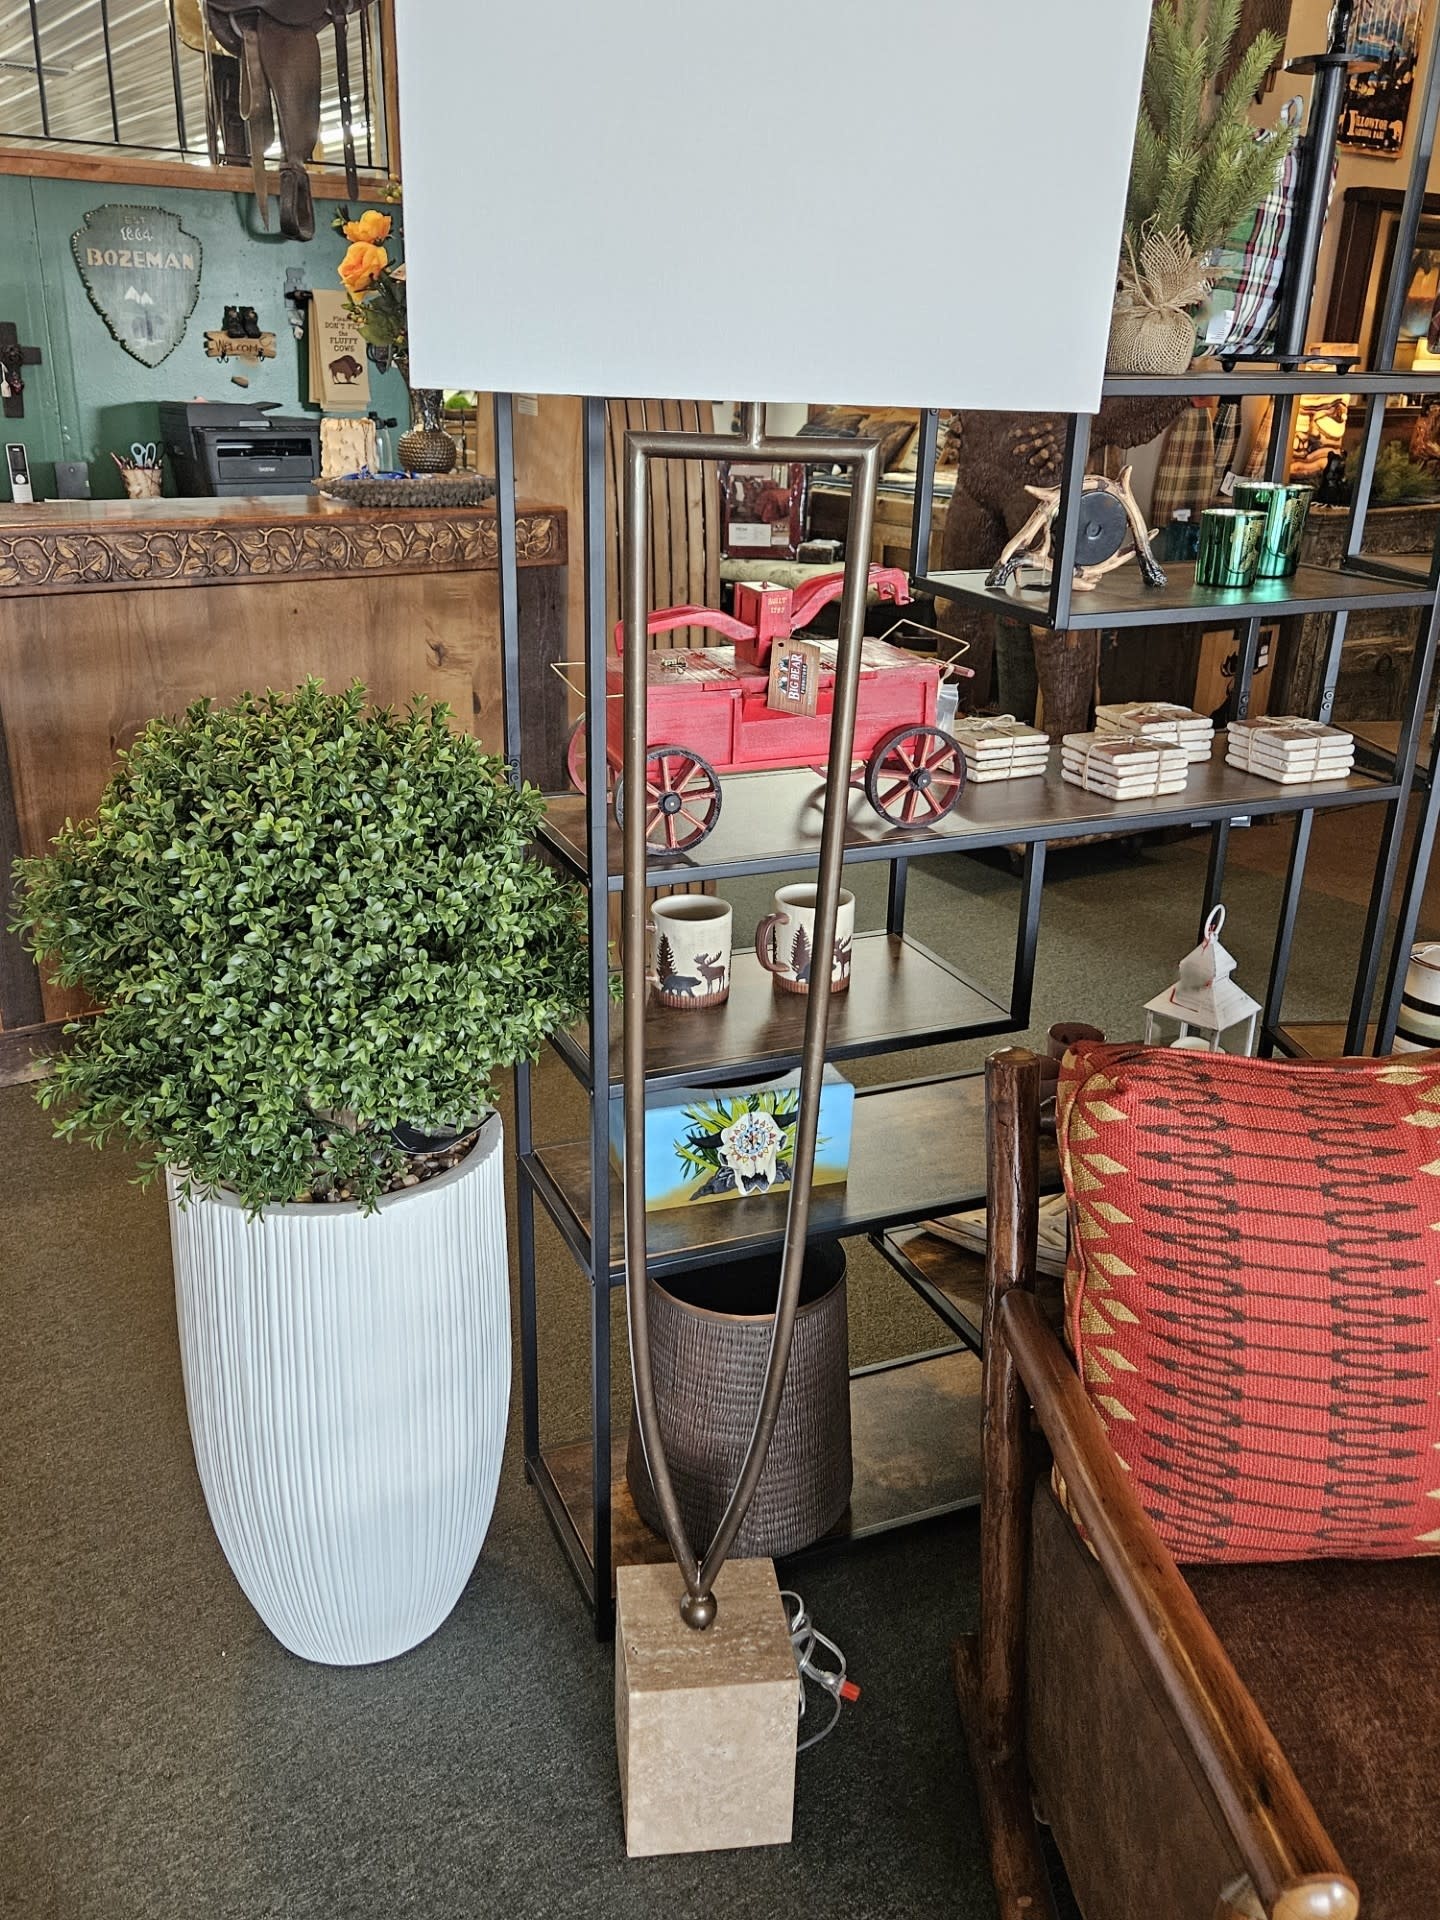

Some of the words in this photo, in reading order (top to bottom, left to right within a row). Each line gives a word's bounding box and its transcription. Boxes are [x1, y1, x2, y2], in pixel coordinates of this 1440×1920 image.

[86, 247, 194, 270] BOZEMAN
[329, 337, 358, 345] FLUFFY
[333, 344, 355, 352] COWS
[789, 654, 802, 680] BEAR
[788, 681, 801, 701] BIG
